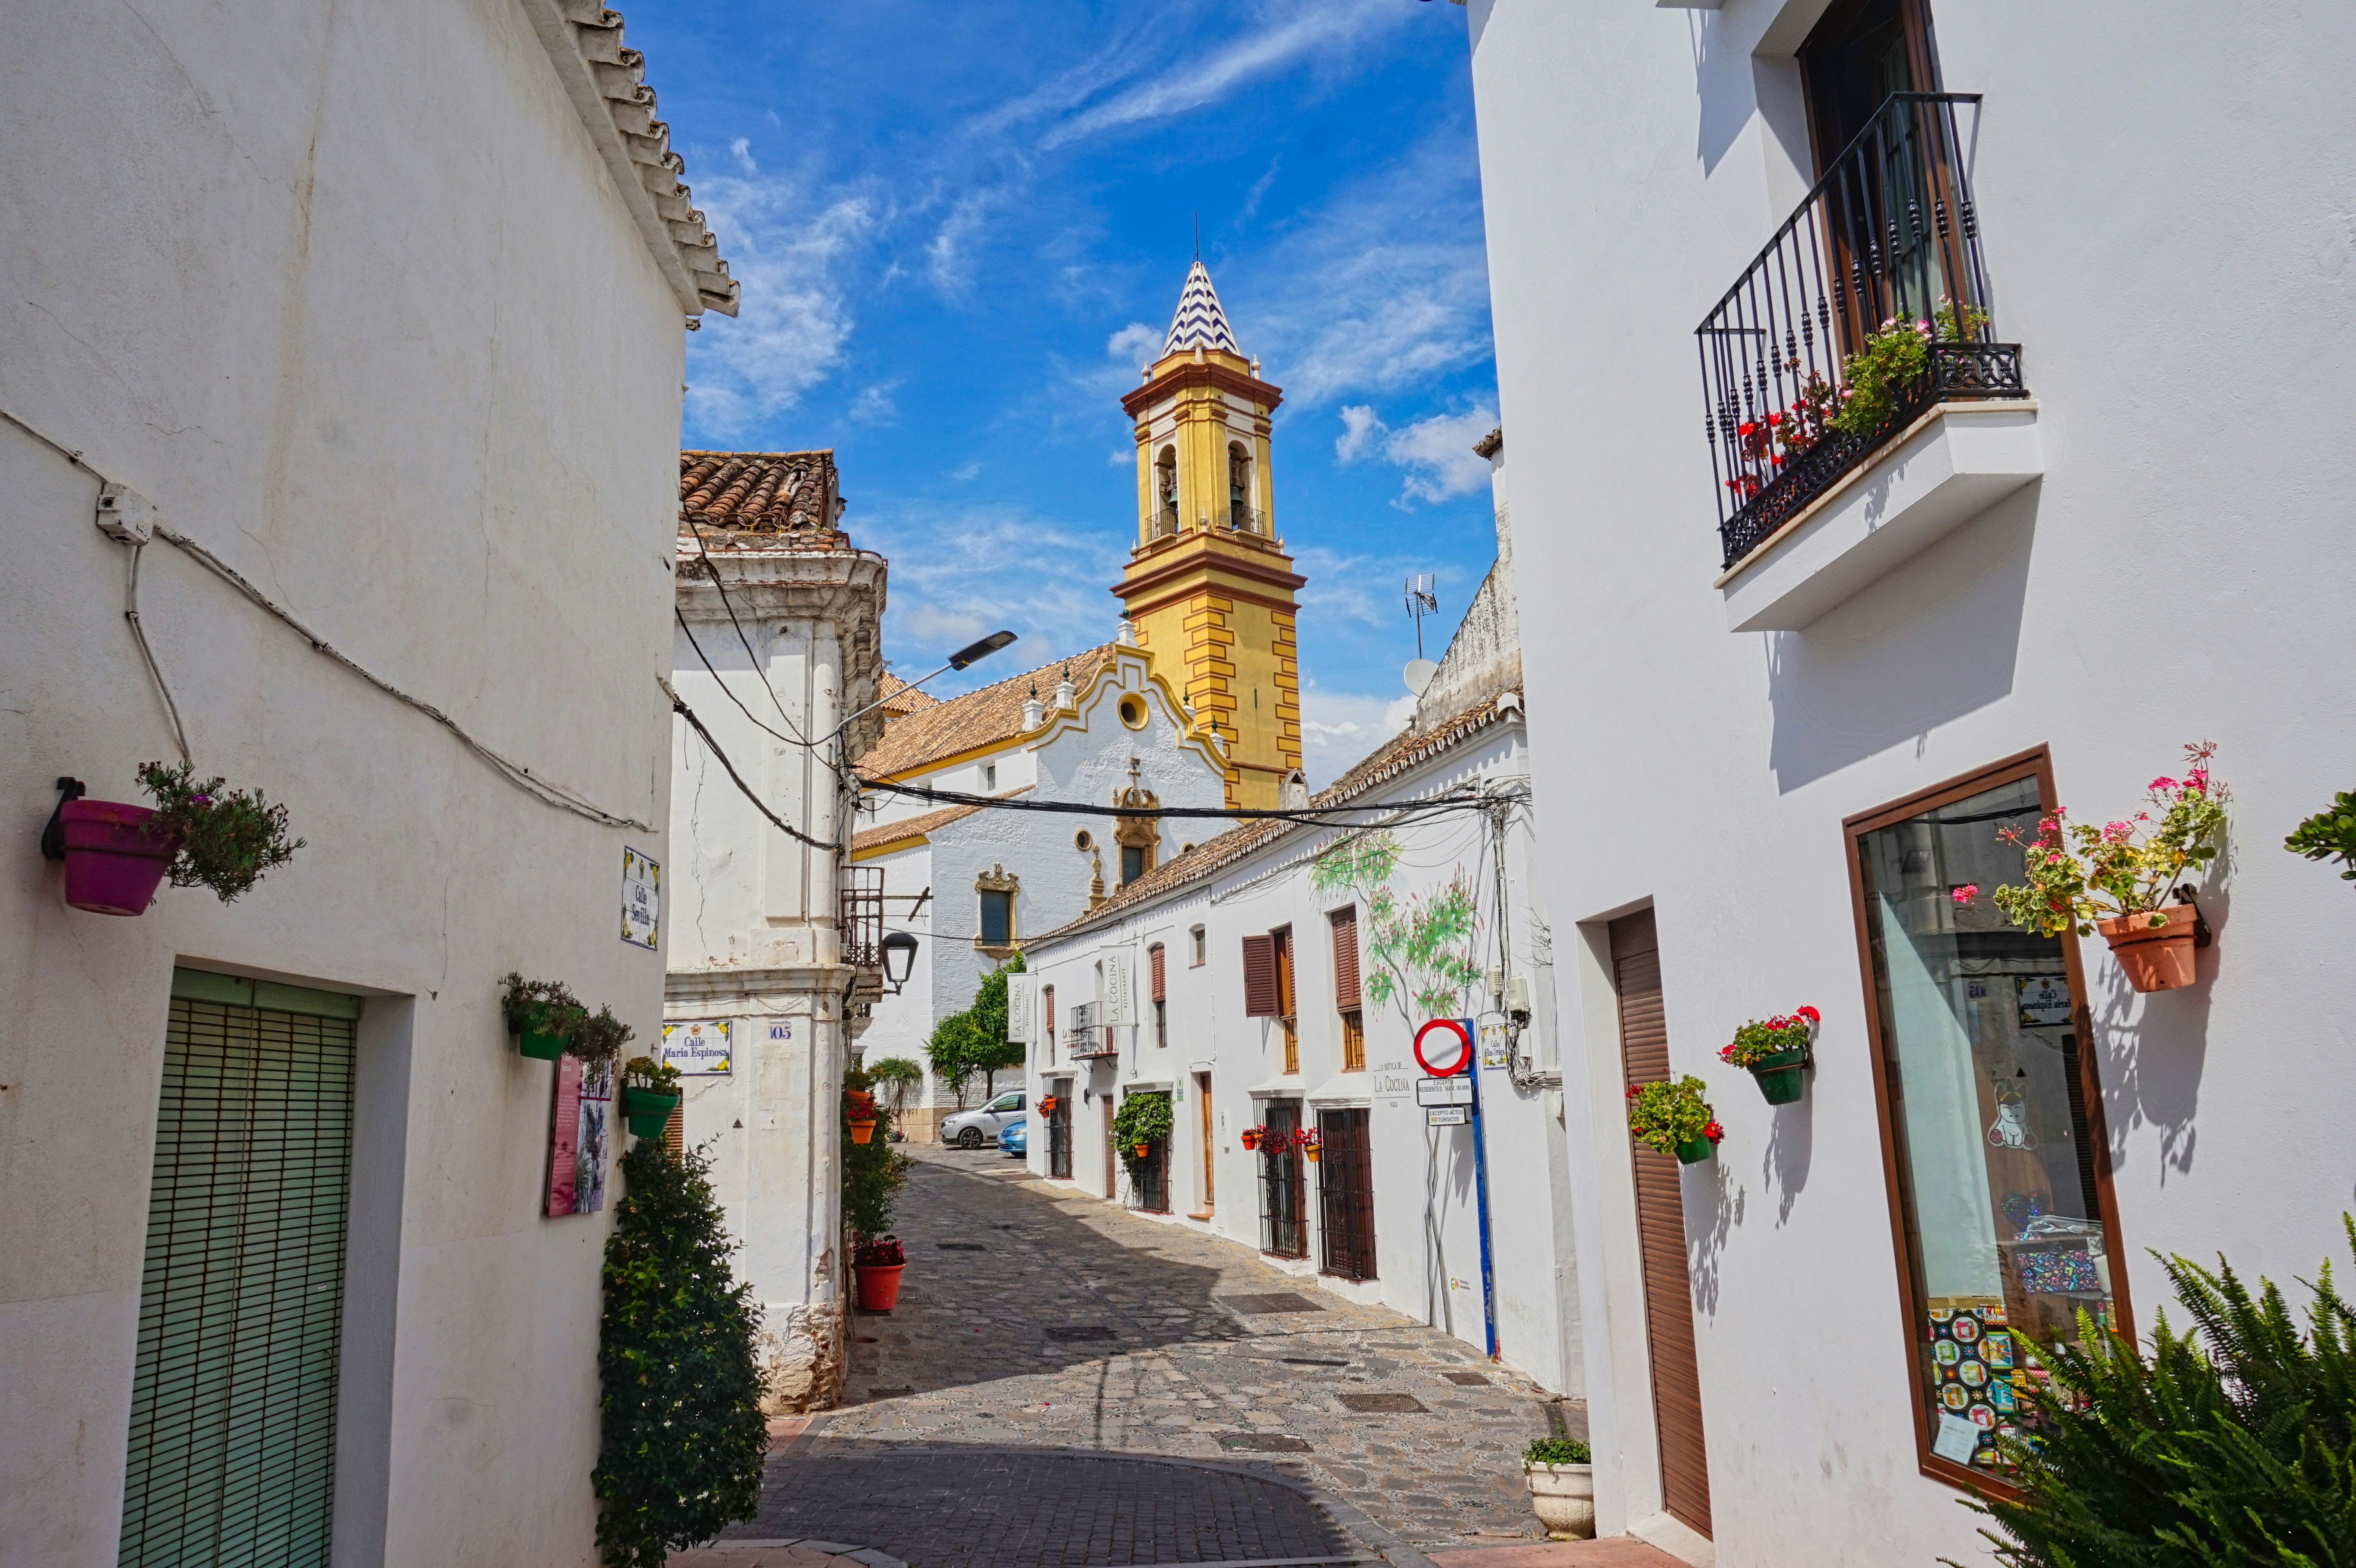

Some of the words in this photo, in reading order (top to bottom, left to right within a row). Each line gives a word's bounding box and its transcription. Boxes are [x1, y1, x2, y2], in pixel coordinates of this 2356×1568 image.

[636, 885, 647, 905] Calle
[632, 903, 649, 926] Sevilla
[1108, 956, 1118, 1003] COCINA
[1110, 1008, 1118, 1022] LA
[770, 1026, 791, 1040] 105
[1014, 1026, 1021, 1037] LA
[684, 1037, 705, 1046] Calle
[664, 1047, 688, 1057] Maria
[691, 1047, 728, 1060] Espinosa
[1384, 1062, 1397, 1071] BOTICA
